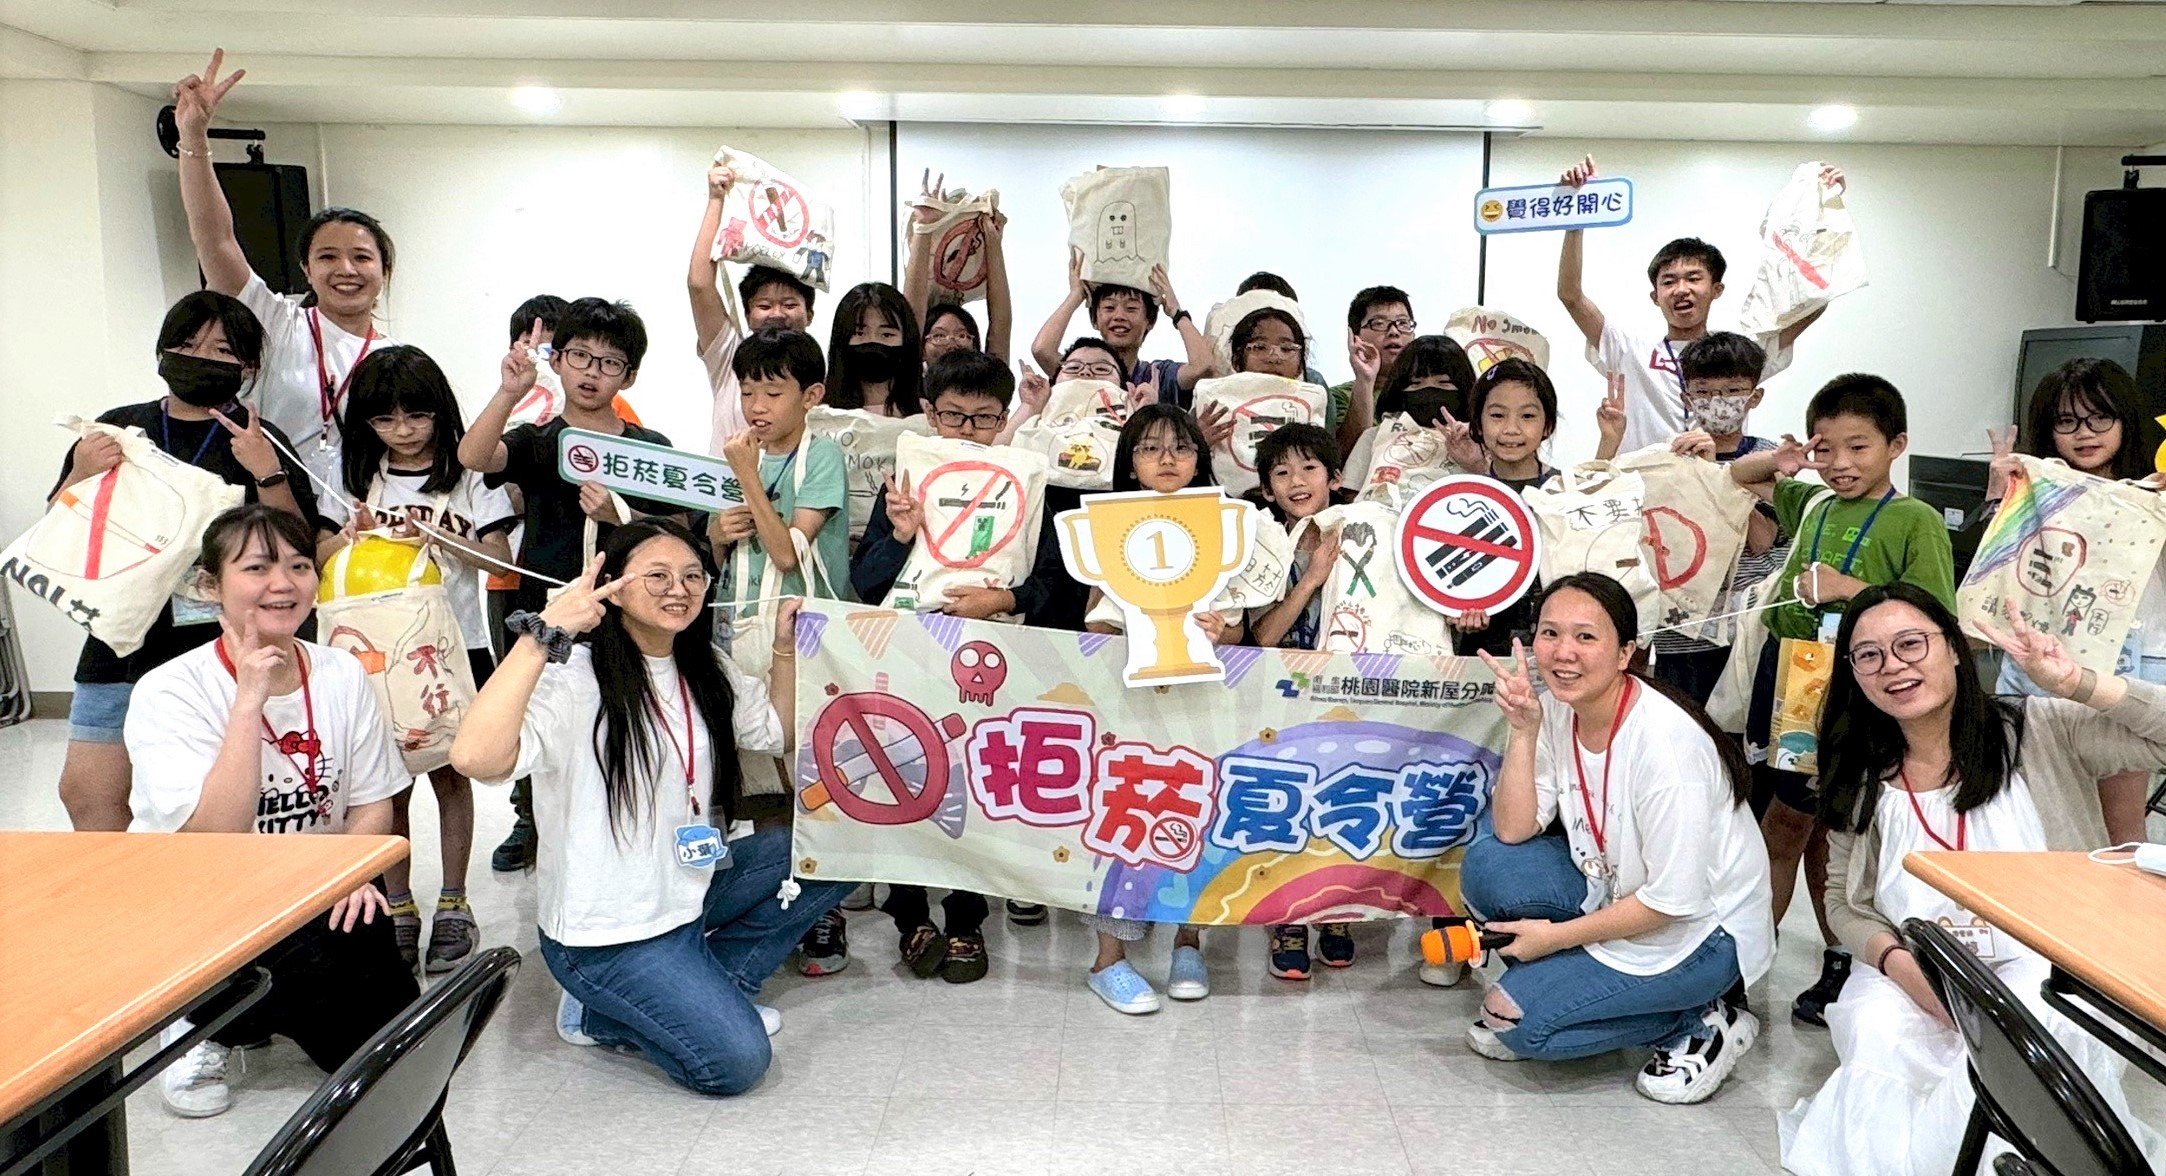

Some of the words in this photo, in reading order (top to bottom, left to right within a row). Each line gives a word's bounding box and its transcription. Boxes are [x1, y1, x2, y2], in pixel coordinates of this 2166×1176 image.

[1506, 191, 1623, 219] 覺得好開心
[602, 451, 745, 504] 拒菸夏令營
[1146, 530, 1175, 571] 1
[972, 712, 1485, 868] 拒菸夏令營
